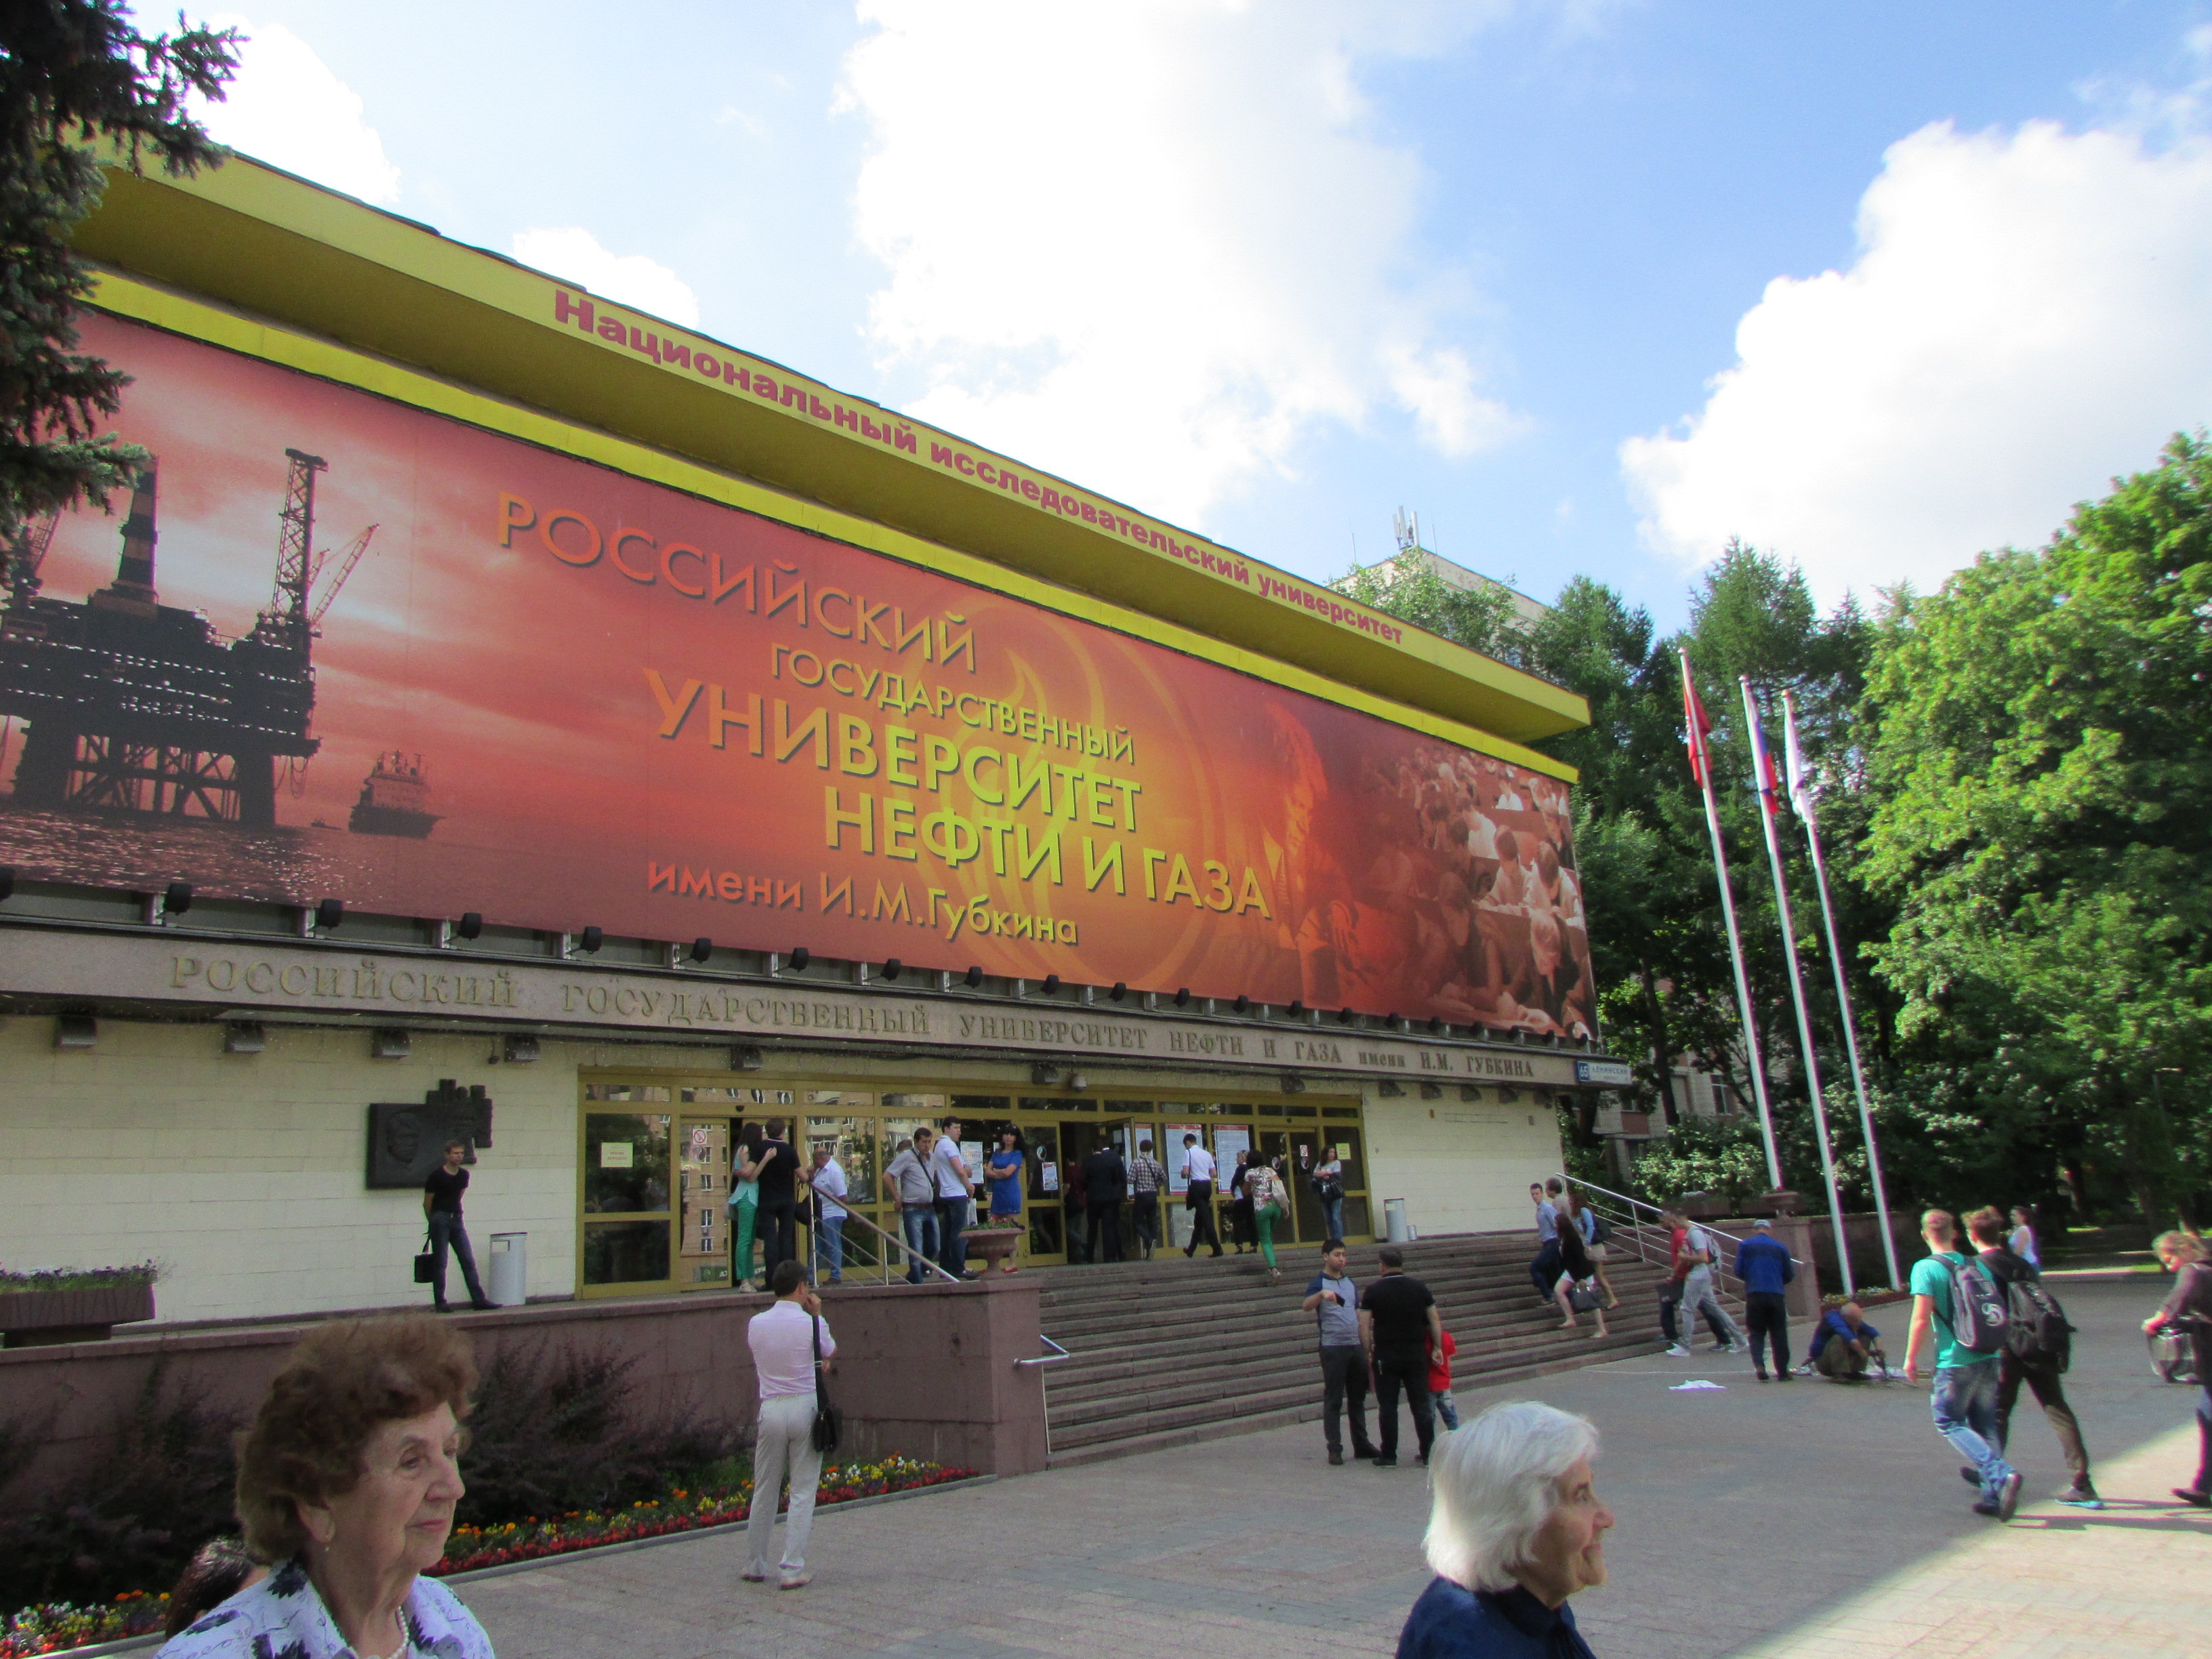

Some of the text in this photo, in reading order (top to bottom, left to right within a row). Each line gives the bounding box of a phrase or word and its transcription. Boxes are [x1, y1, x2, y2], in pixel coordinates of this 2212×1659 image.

[554, 289, 1403, 644] Национальный исследовательский университет
[498, 491, 976, 672] РОССИЙСКИЙ
[643, 668, 1142, 832] УНИВЕРСИТЕТ
[771, 642, 1134, 764] ГОСУДАРСТВЕННЫЙ
[648, 861, 802, 909] имени
[825, 786, 1273, 920] НЕФТИ И ГАЗА
[170, 956, 1534, 1078] РОССИЙСКИЙ ГОСУДАРСТВЕННЫЙ УНИВЕРСИТЕТ НЕФТИ И ГАЗА имени И.М. ГУБКИНА
[1580, 1065, 1589, 1078] 65
